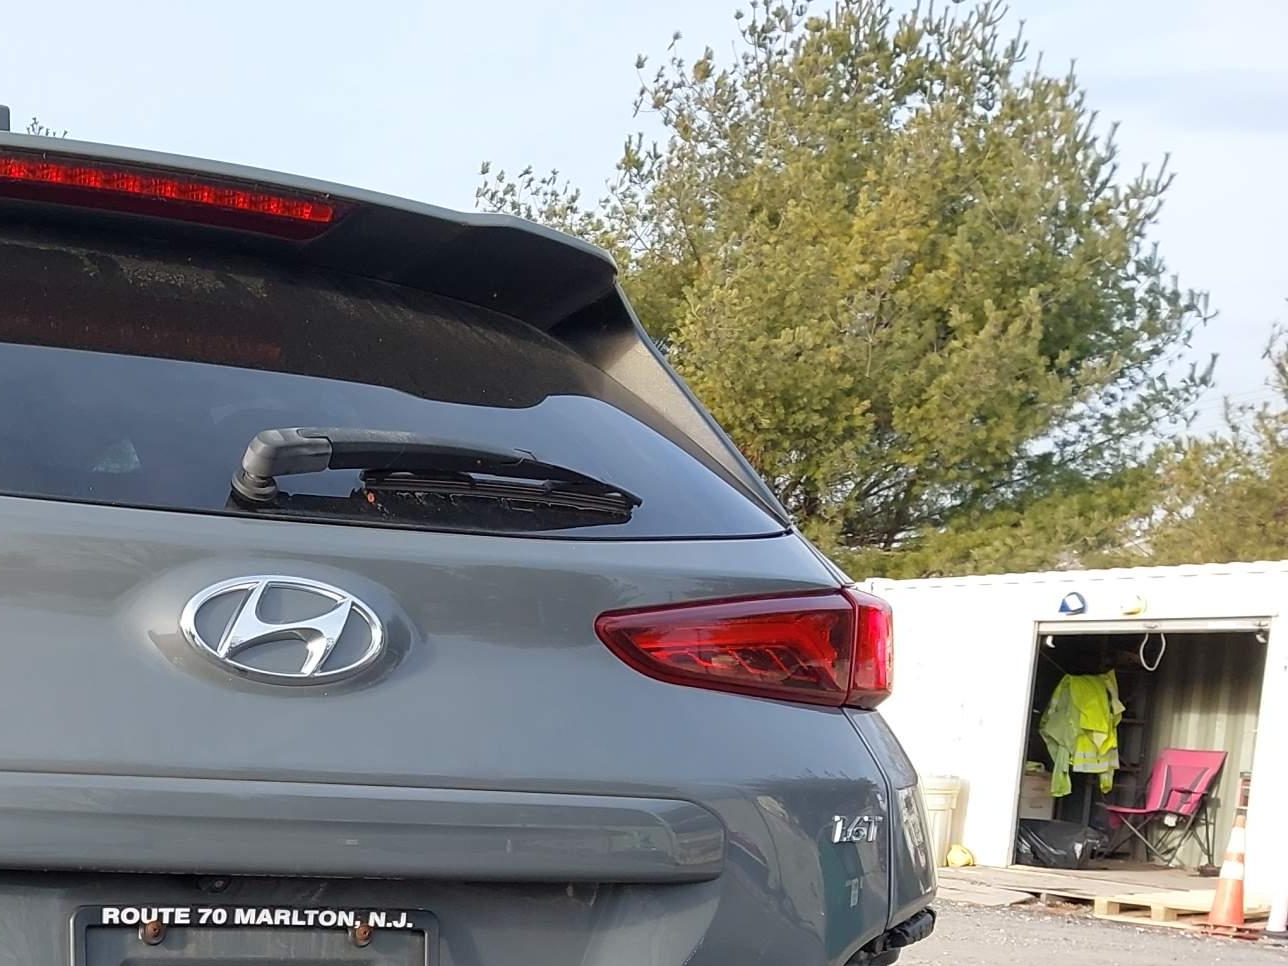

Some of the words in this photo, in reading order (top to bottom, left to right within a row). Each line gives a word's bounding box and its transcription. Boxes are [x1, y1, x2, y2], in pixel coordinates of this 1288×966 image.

[102, 907, 190, 925] ROUTE
[198, 908, 227, 925] 70
[368, 911, 413, 928] N.J.
